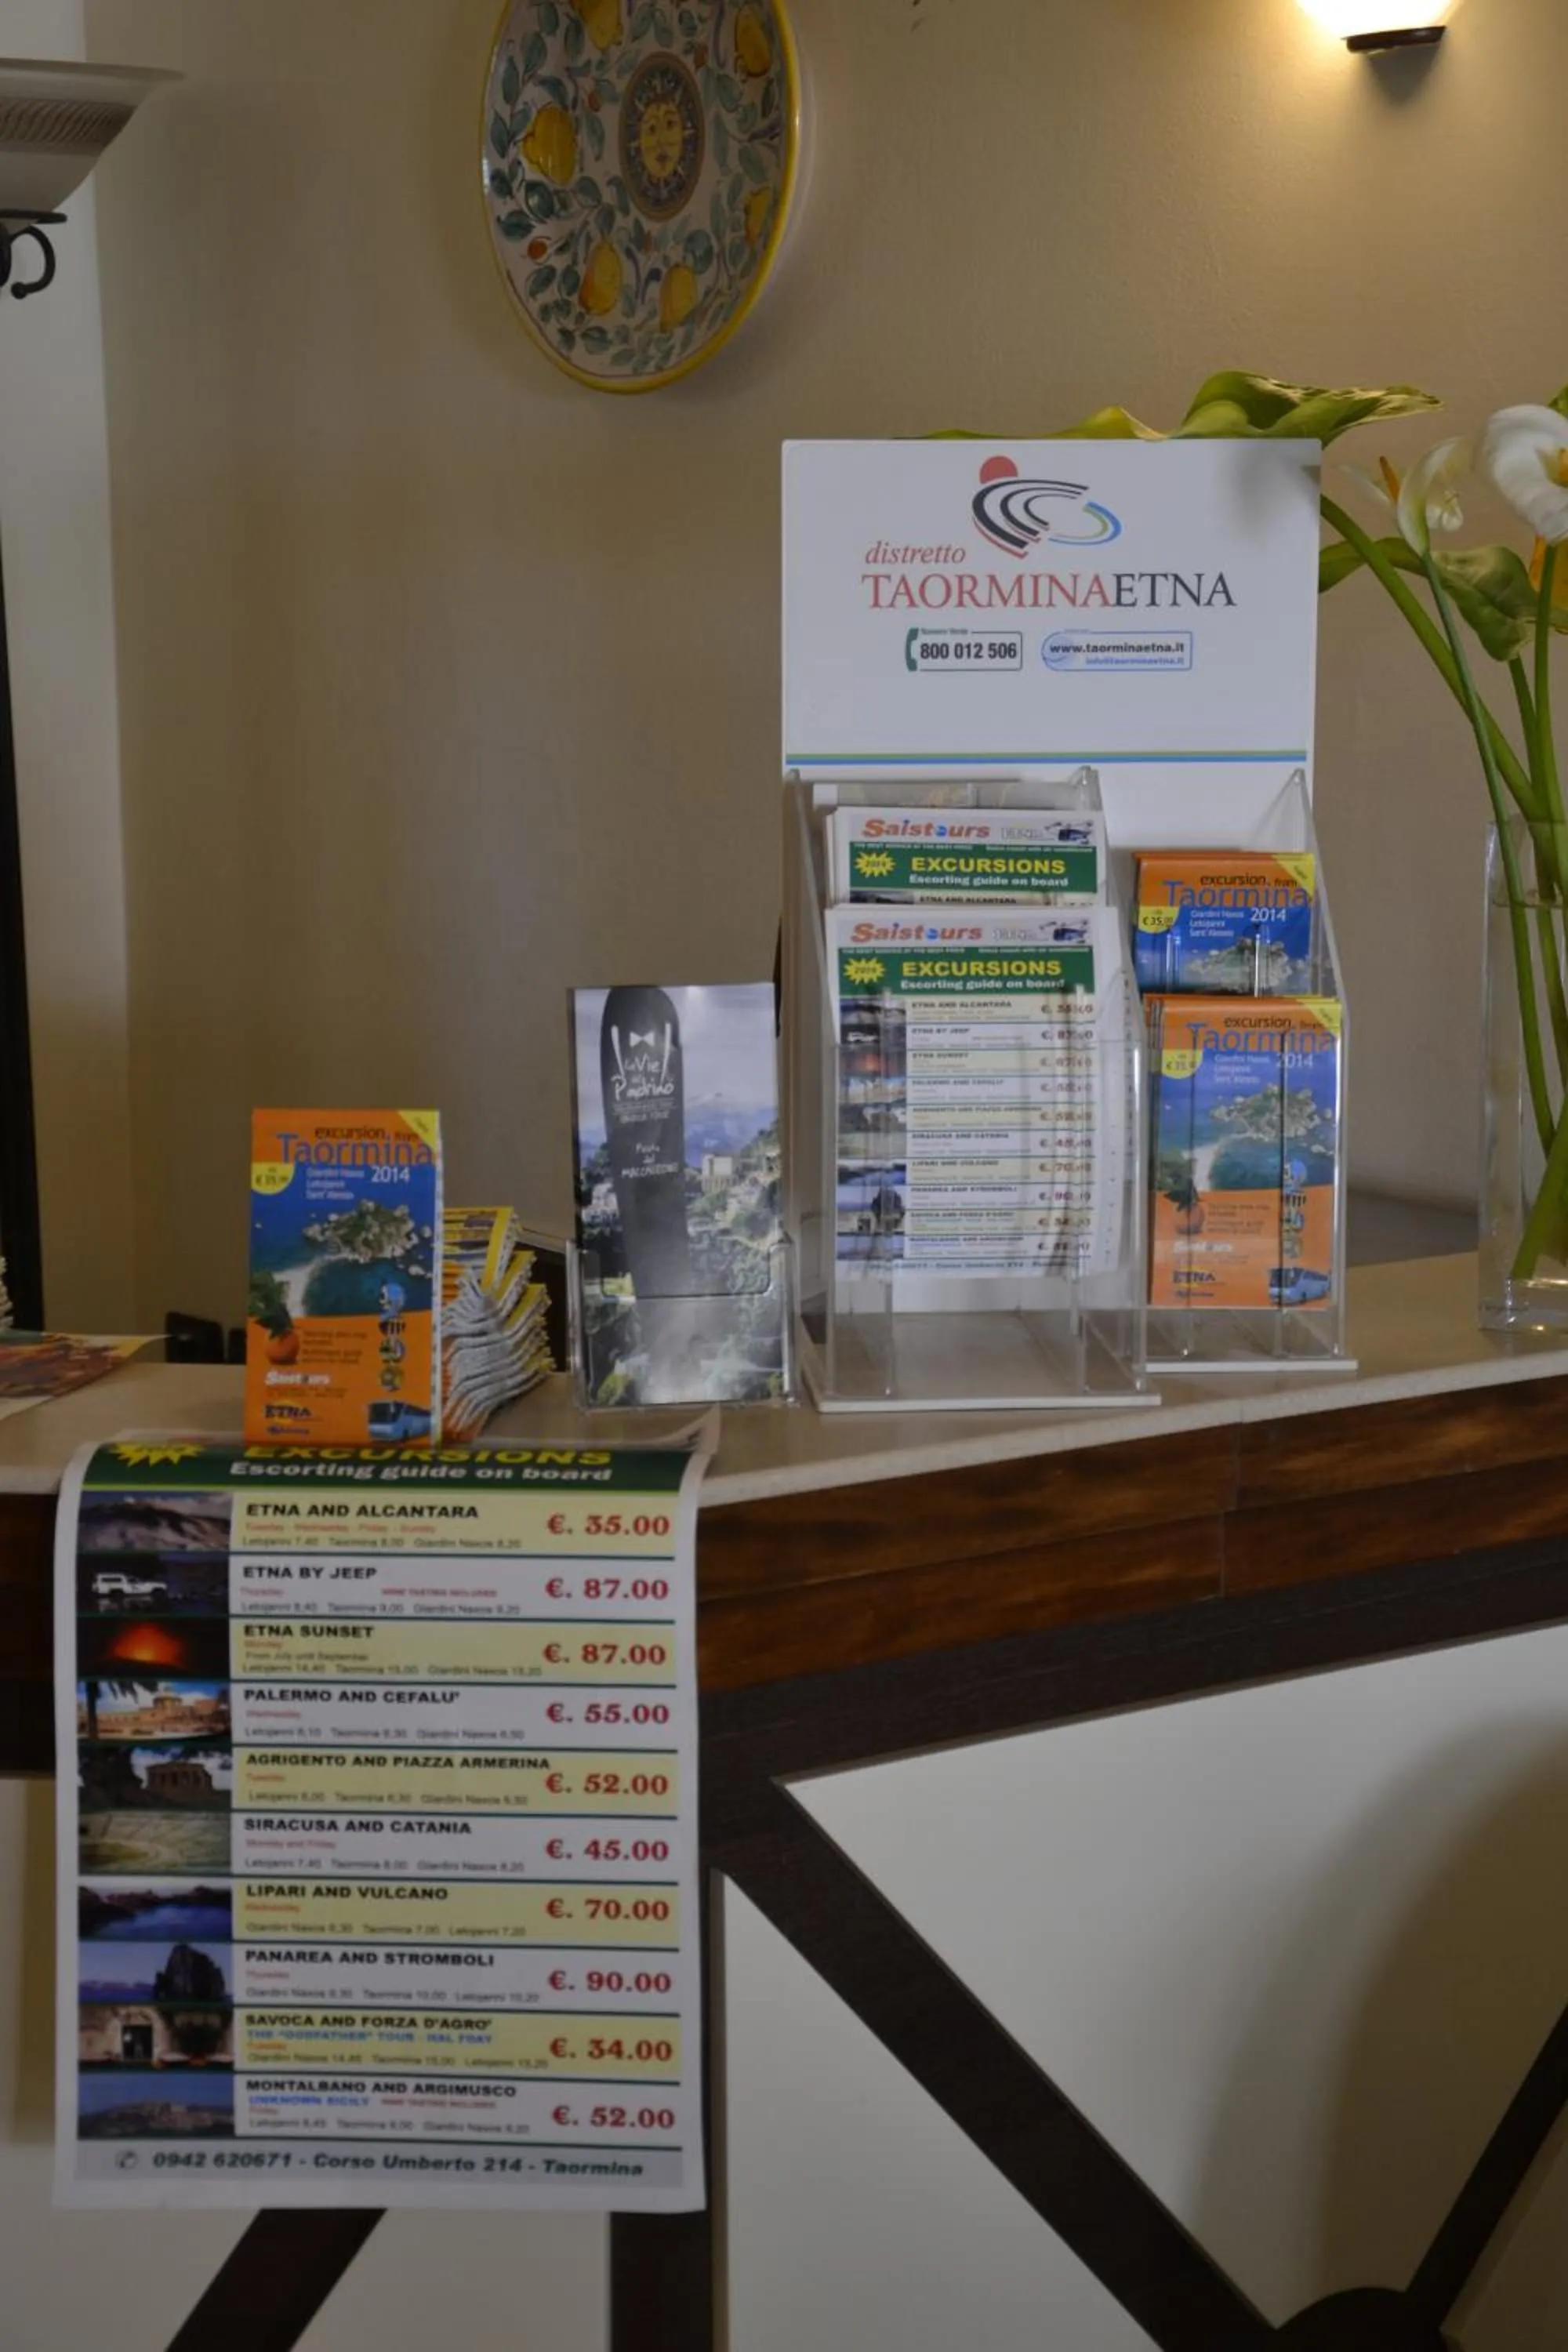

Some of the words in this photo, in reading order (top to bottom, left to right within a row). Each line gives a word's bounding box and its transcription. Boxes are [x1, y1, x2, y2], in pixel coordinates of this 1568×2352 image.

[864, 542, 966, 564] distretto
[862, 572, 1236, 609] TAORMINAETNA
[920, 642, 949, 660] 800
[953, 642, 983, 660] 012
[988, 642, 1018, 660] 506
[1050, 641, 1185, 655] www.taorminaetna.it
[861, 819, 991, 839] Saistours
[911, 857, 1066, 874] EXCURSIONS
[909, 874, 970, 887] Escorting
[973, 875, 1007, 887] guide
[1031, 876, 1069, 887] board
[1200, 873, 1266, 886] excursion
[1163, 880, 1309, 907] Taormina
[1250, 908, 1287, 922] 2014
[851, 922, 983, 943] Saistours
[902, 960, 1062, 977] EXCURSIONS
[901, 979, 963, 991] Escorting
[965, 980, 1003, 991] guide
[1224, 1015, 1292, 1029] excursion
[1186, 1023, 1335, 1052] Taormina
[1276, 1053, 1313, 1068] 2014
[314, 1125, 386, 1140] excursion
[276, 1133, 434, 1164] Taormina
[371, 1165, 410, 1183] 2014
[230, 1461, 372, 1479] Escorting
[379, 1465, 466, 1480] guide
[475, 1468, 513, 1479] on
[521, 1466, 613, 1480] board
[246, 1504, 299, 1517] ETNA
[307, 1504, 350, 1518] AND
[357, 1504, 479, 1519] ALCANTARA
[584, 1515, 670, 1536] 35.00
[242, 1566, 292, 1579] ETNA
[299, 1567, 324, 1579] BY
[329, 1567, 377, 1580] JEEP
[583, 1578, 669, 1600] 87.00
[243, 1624, 294, 1638] ETNA
[300, 1625, 375, 1639] SUNSET
[581, 1644, 666, 1665] 87.00
[244, 1689, 332, 1702] PALERMO
[338, 1690, 377, 1703] AND
[383, 1691, 460, 1704] CEFALU'
[585, 1703, 670, 1724] 55.00
[246, 1754, 347, 1766] AGRIGENTO
[353, 1755, 387, 1768] AND
[393, 1756, 454, 1769] PIAZZA
[460, 1757, 550, 1769] ARMERINA
[583, 1773, 669, 1795] 52.00
[244, 1819, 339, 1831] SIRACUSA
[345, 1820, 384, 1832] AND
[390, 1820, 471, 1835] CATANIA
[583, 1839, 669, 1861] 45.00
[246, 1886, 306, 1897] LIPARI
[312, 1886, 351, 1898] AND
[358, 1886, 448, 1900] VULCANO
[585, 1899, 670, 1921] 70.00
[245, 1950, 333, 1963] PANAREA
[339, 1951, 378, 1965] AND
[384, 1952, 494, 1966] STROMBOLI
[586, 1971, 671, 1993] 90.00
[245, 2014, 314, 2027] SAVOCA
[321, 2016, 356, 2027] AND
[361, 2016, 418, 2028] FORZA
[587, 2039, 673, 2061] 34.00
[246, 2080, 367, 2093] MONTALBANO
[372, 2081, 408, 2094] AND
[413, 2082, 517, 2098] ARGIMUSCO
[590, 2107, 675, 2129] 52.00
[153, 2152, 206, 2168] 0942
[212, 2152, 293, 2169] 620671
[314, 2153, 376, 2169] Corso
[382, 2154, 476, 2172] Umberto
[483, 2158, 523, 2173] 214
[543, 2159, 644, 2176] Taormina
